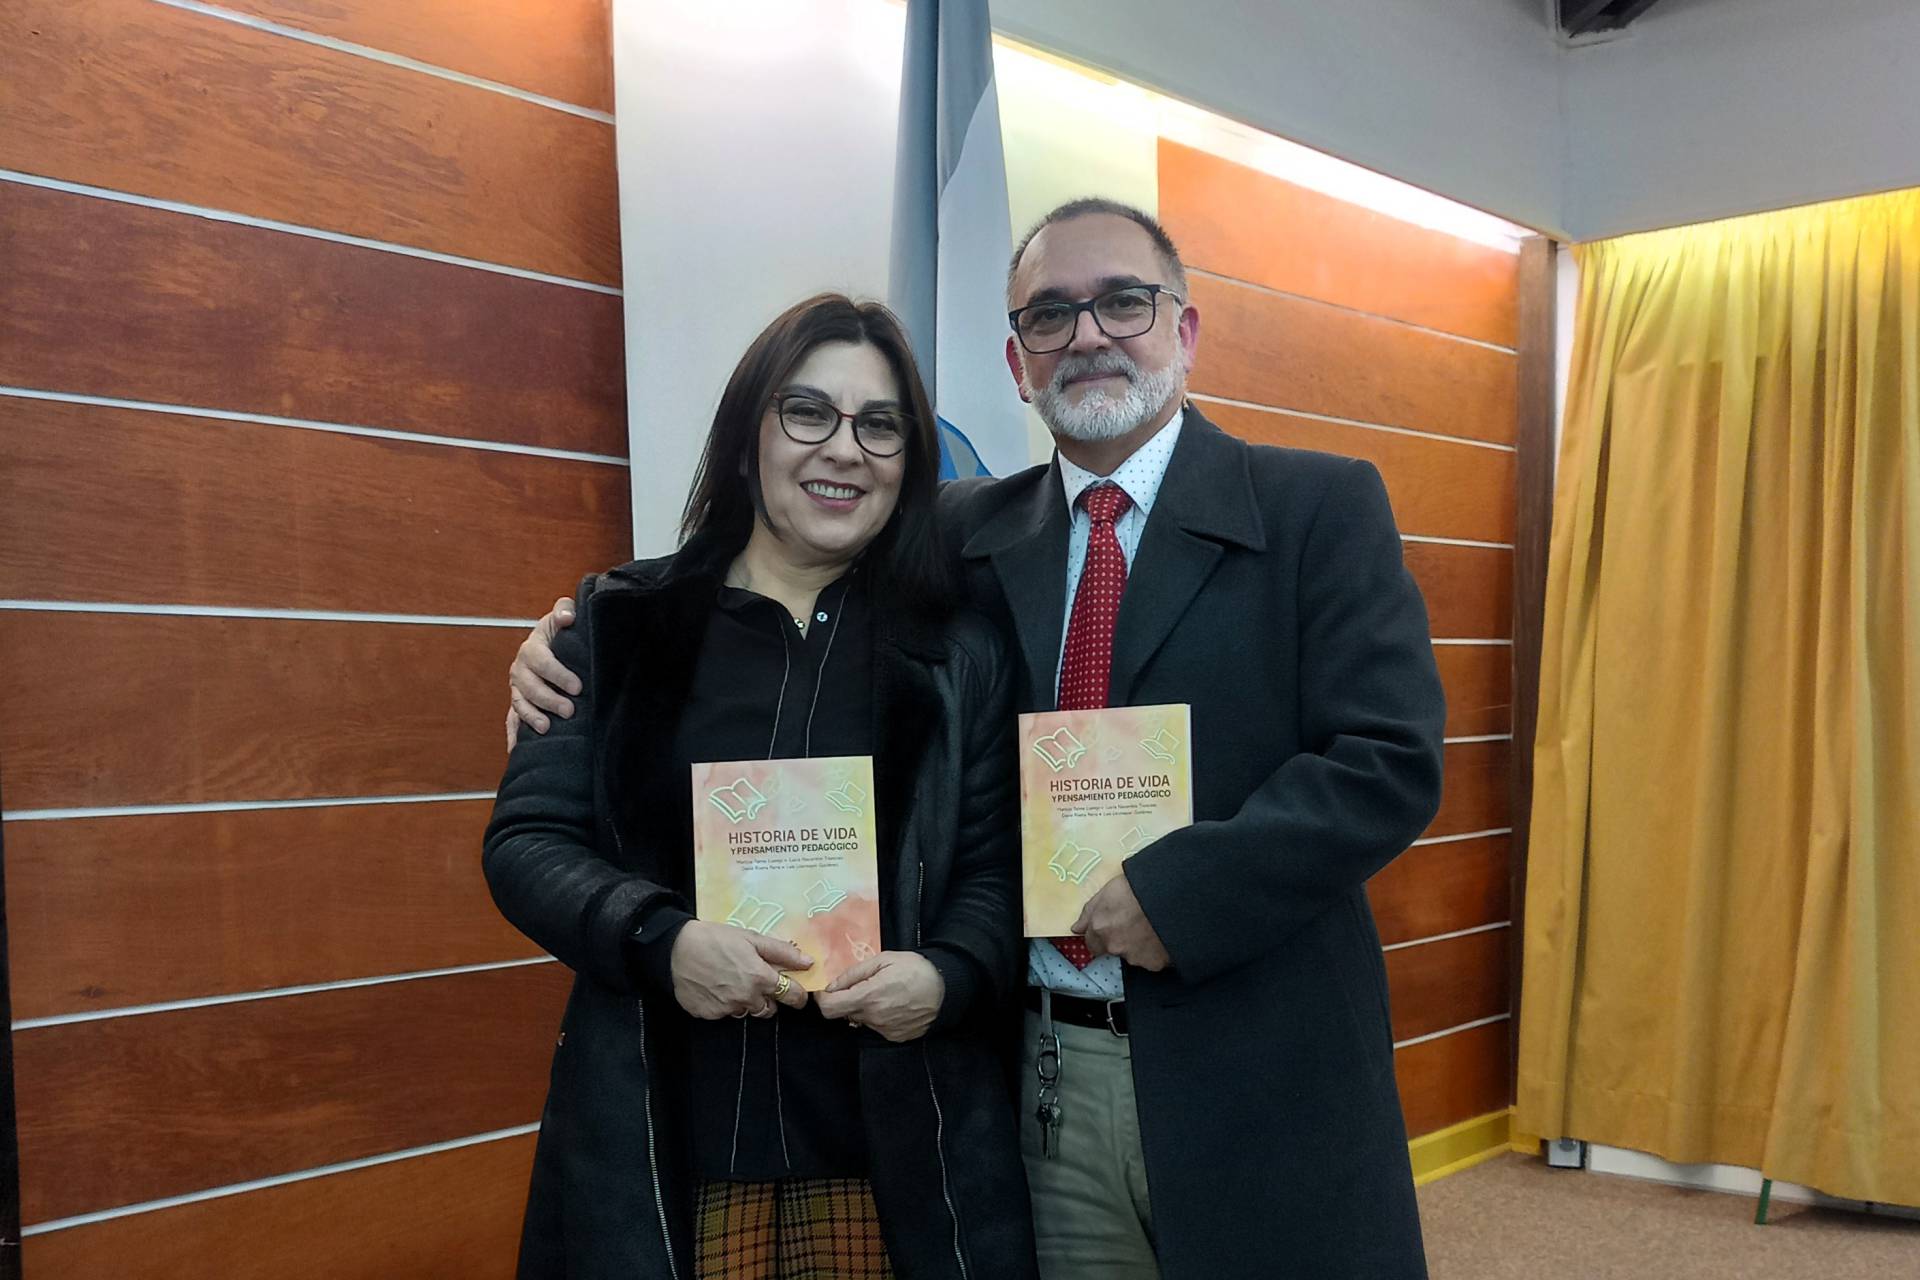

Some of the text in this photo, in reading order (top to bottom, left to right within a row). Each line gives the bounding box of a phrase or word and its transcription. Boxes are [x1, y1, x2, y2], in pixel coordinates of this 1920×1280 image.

[1050, 774, 1170, 792] HISTORIA DE VIDA
[1057, 792, 1115, 803] PENSAMIENTO
[1118, 789, 1171, 800] PEDAGÓGICO
[728, 827, 857, 844] HISTORIA DE VIDA
[737, 844, 799, 855] PENSAMIENTO
[801, 842, 858, 853] PEDAGÓGICO
